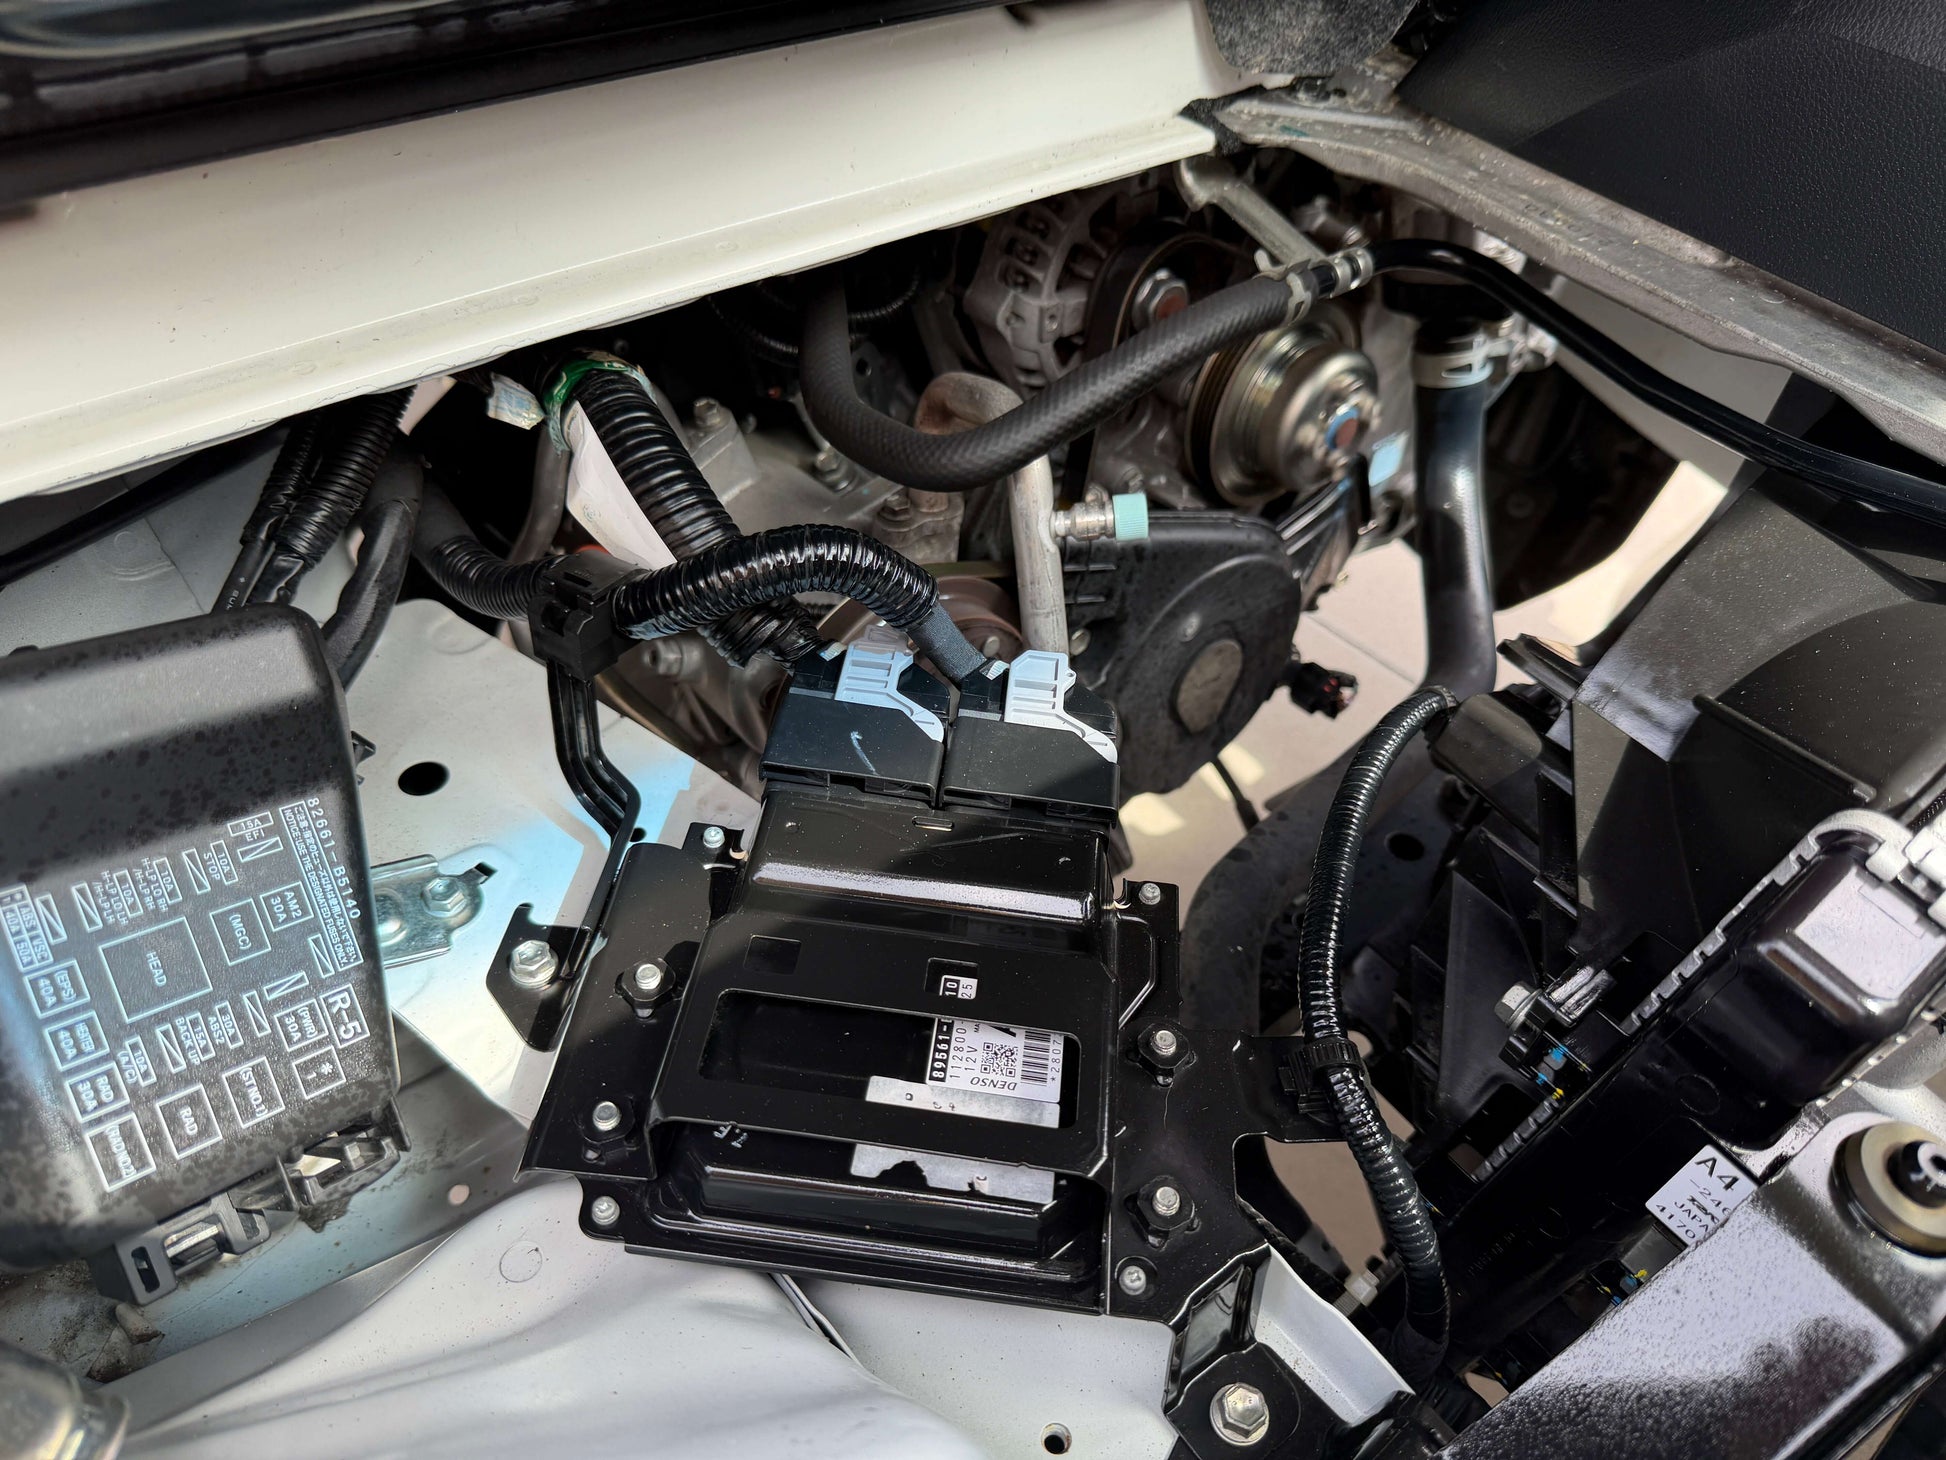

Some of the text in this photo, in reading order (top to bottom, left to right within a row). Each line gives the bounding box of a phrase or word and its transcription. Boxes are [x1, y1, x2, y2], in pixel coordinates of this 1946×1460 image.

[241, 818, 261, 831] 15A
[245, 828, 264, 842] EFI
[203, 852, 220, 881] STOP
[217, 852, 231, 873] 10A
[306, 797, 361, 919] 82661-B5140
[120, 883, 134, 904] 10A
[140, 857, 156, 881] H-LP
[156, 898, 168, 912] RH
[160, 870, 174, 891] 10A
[104, 909, 115, 923] LH
[144, 896, 155, 910] RH
[270, 896, 287, 923] 30A
[283, 890, 302, 918] AM2
[301, 856, 312, 870] THE
[307, 871, 330, 918] DESIGNATED
[325, 918, 340, 942] FUSES
[334, 943, 348, 966] ONLY.
[19, 905, 48, 960] ABS VSC
[116, 911, 128, 926] LH
[228, 913, 251, 950] (MGC)
[4, 910, 33, 964] 40A 50A
[145, 951, 167, 987] HEAD
[36, 976, 57, 1008] 40A
[53, 969, 77, 1003] (EPS)
[945, 982, 958, 996] 10
[961, 984, 972, 998] 25
[206, 1015, 225, 1045] ABS2
[221, 1013, 235, 1036] 30A
[284, 1015, 302, 1042] 30A
[296, 1006, 318, 1039] (PWR)
[326, 991, 362, 1041] R-5
[56, 1028, 78, 1060] 40A
[174, 1016, 200, 1066] BACK UP
[192, 1026, 207, 1048] 15A
[132, 1049, 148, 1073] 10A
[964, 1046, 978, 1070] 12V
[76, 1081, 98, 1112] 30A
[95, 1075, 115, 1103] RAD
[970, 1076, 1017, 1090] DENSO
[178, 1107, 198, 1136] RAD
[1695, 1156, 1739, 1191] A4
